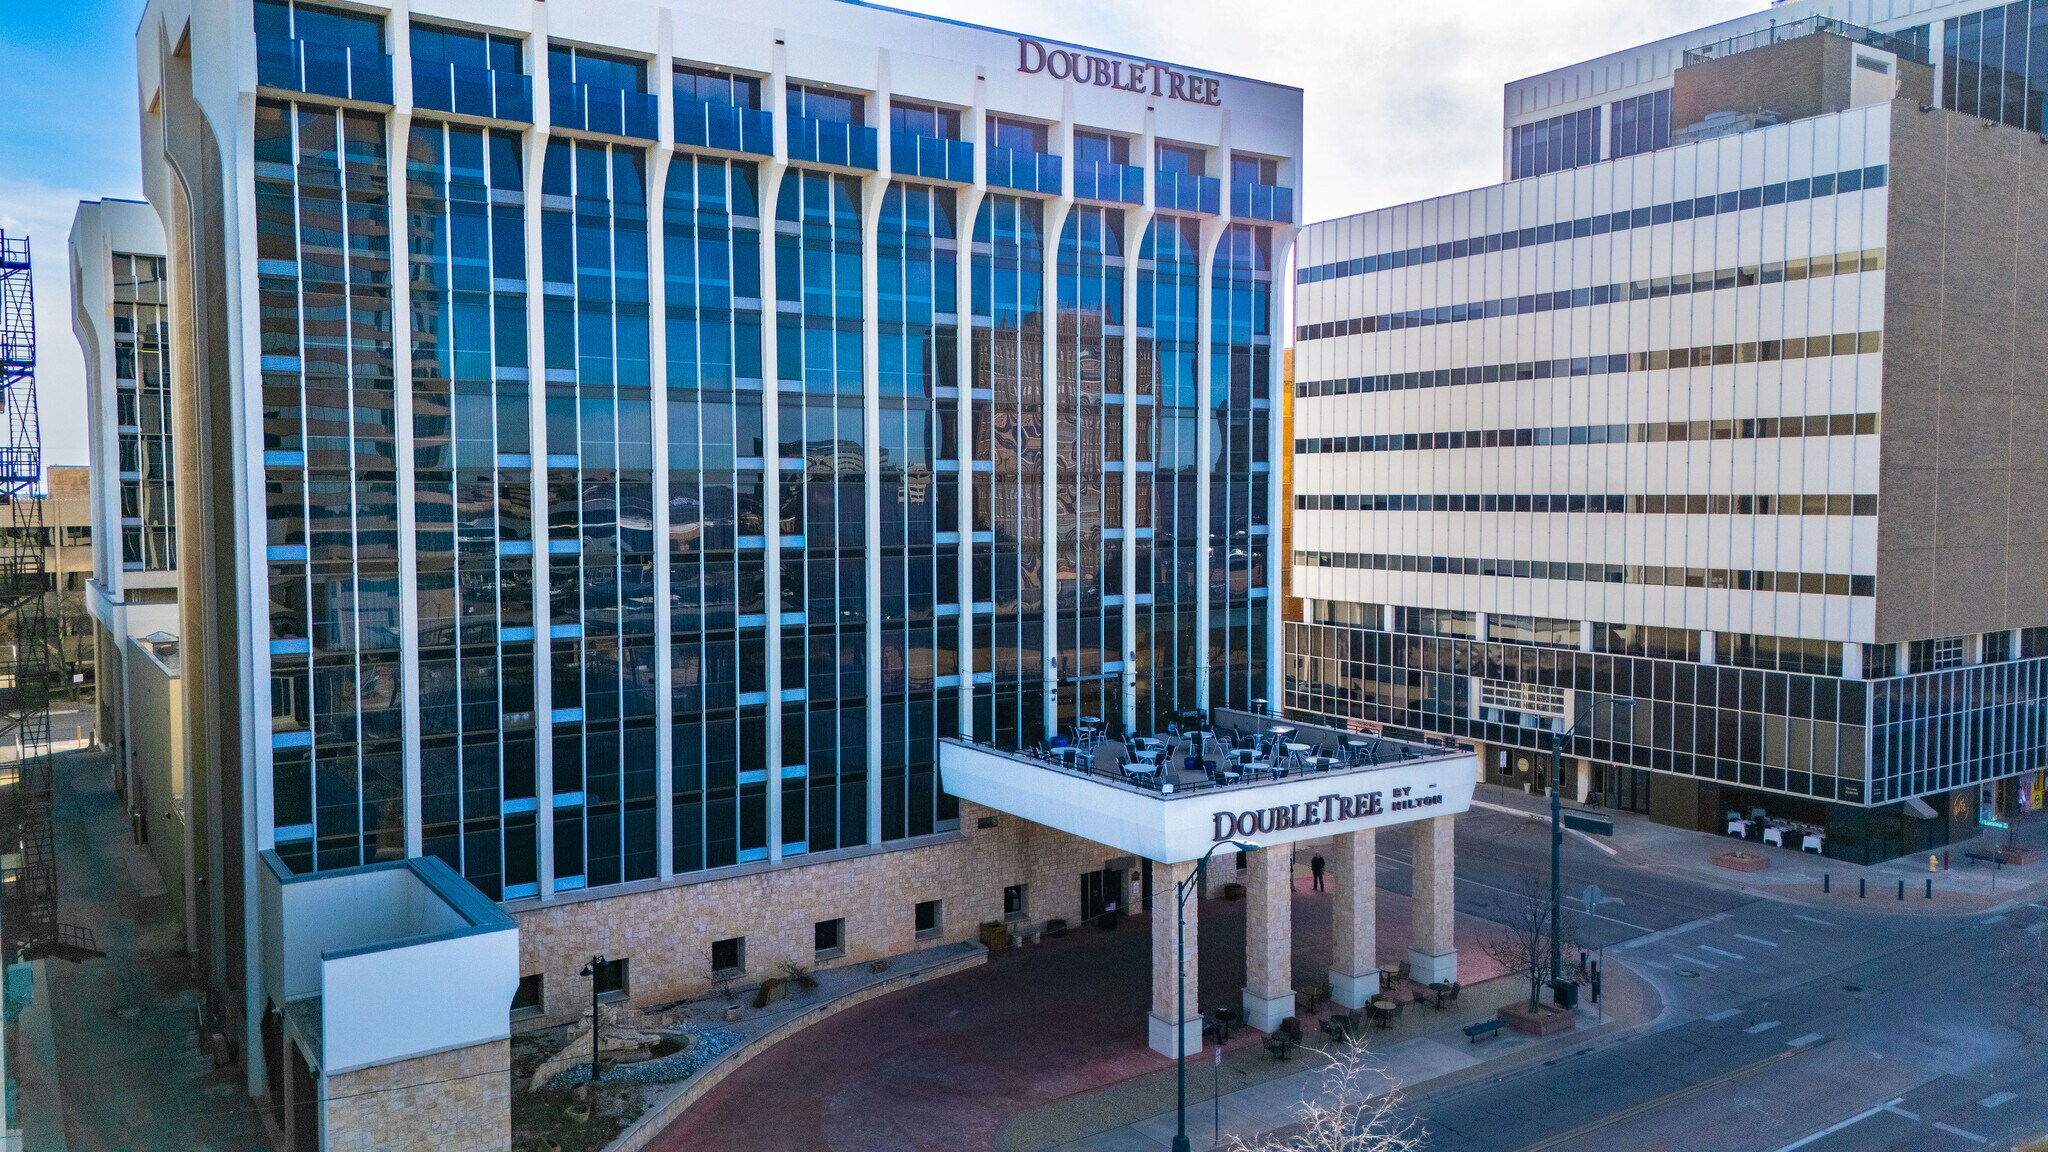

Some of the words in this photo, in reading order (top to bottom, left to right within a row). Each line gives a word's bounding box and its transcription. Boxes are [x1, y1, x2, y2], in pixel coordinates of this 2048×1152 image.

[1017, 38, 1222, 107] DOUBLETREE
[1391, 794, 1443, 811] HILTON
[1392, 786, 1412, 798] BY
[1213, 791, 1384, 842] DOUBLETREE
